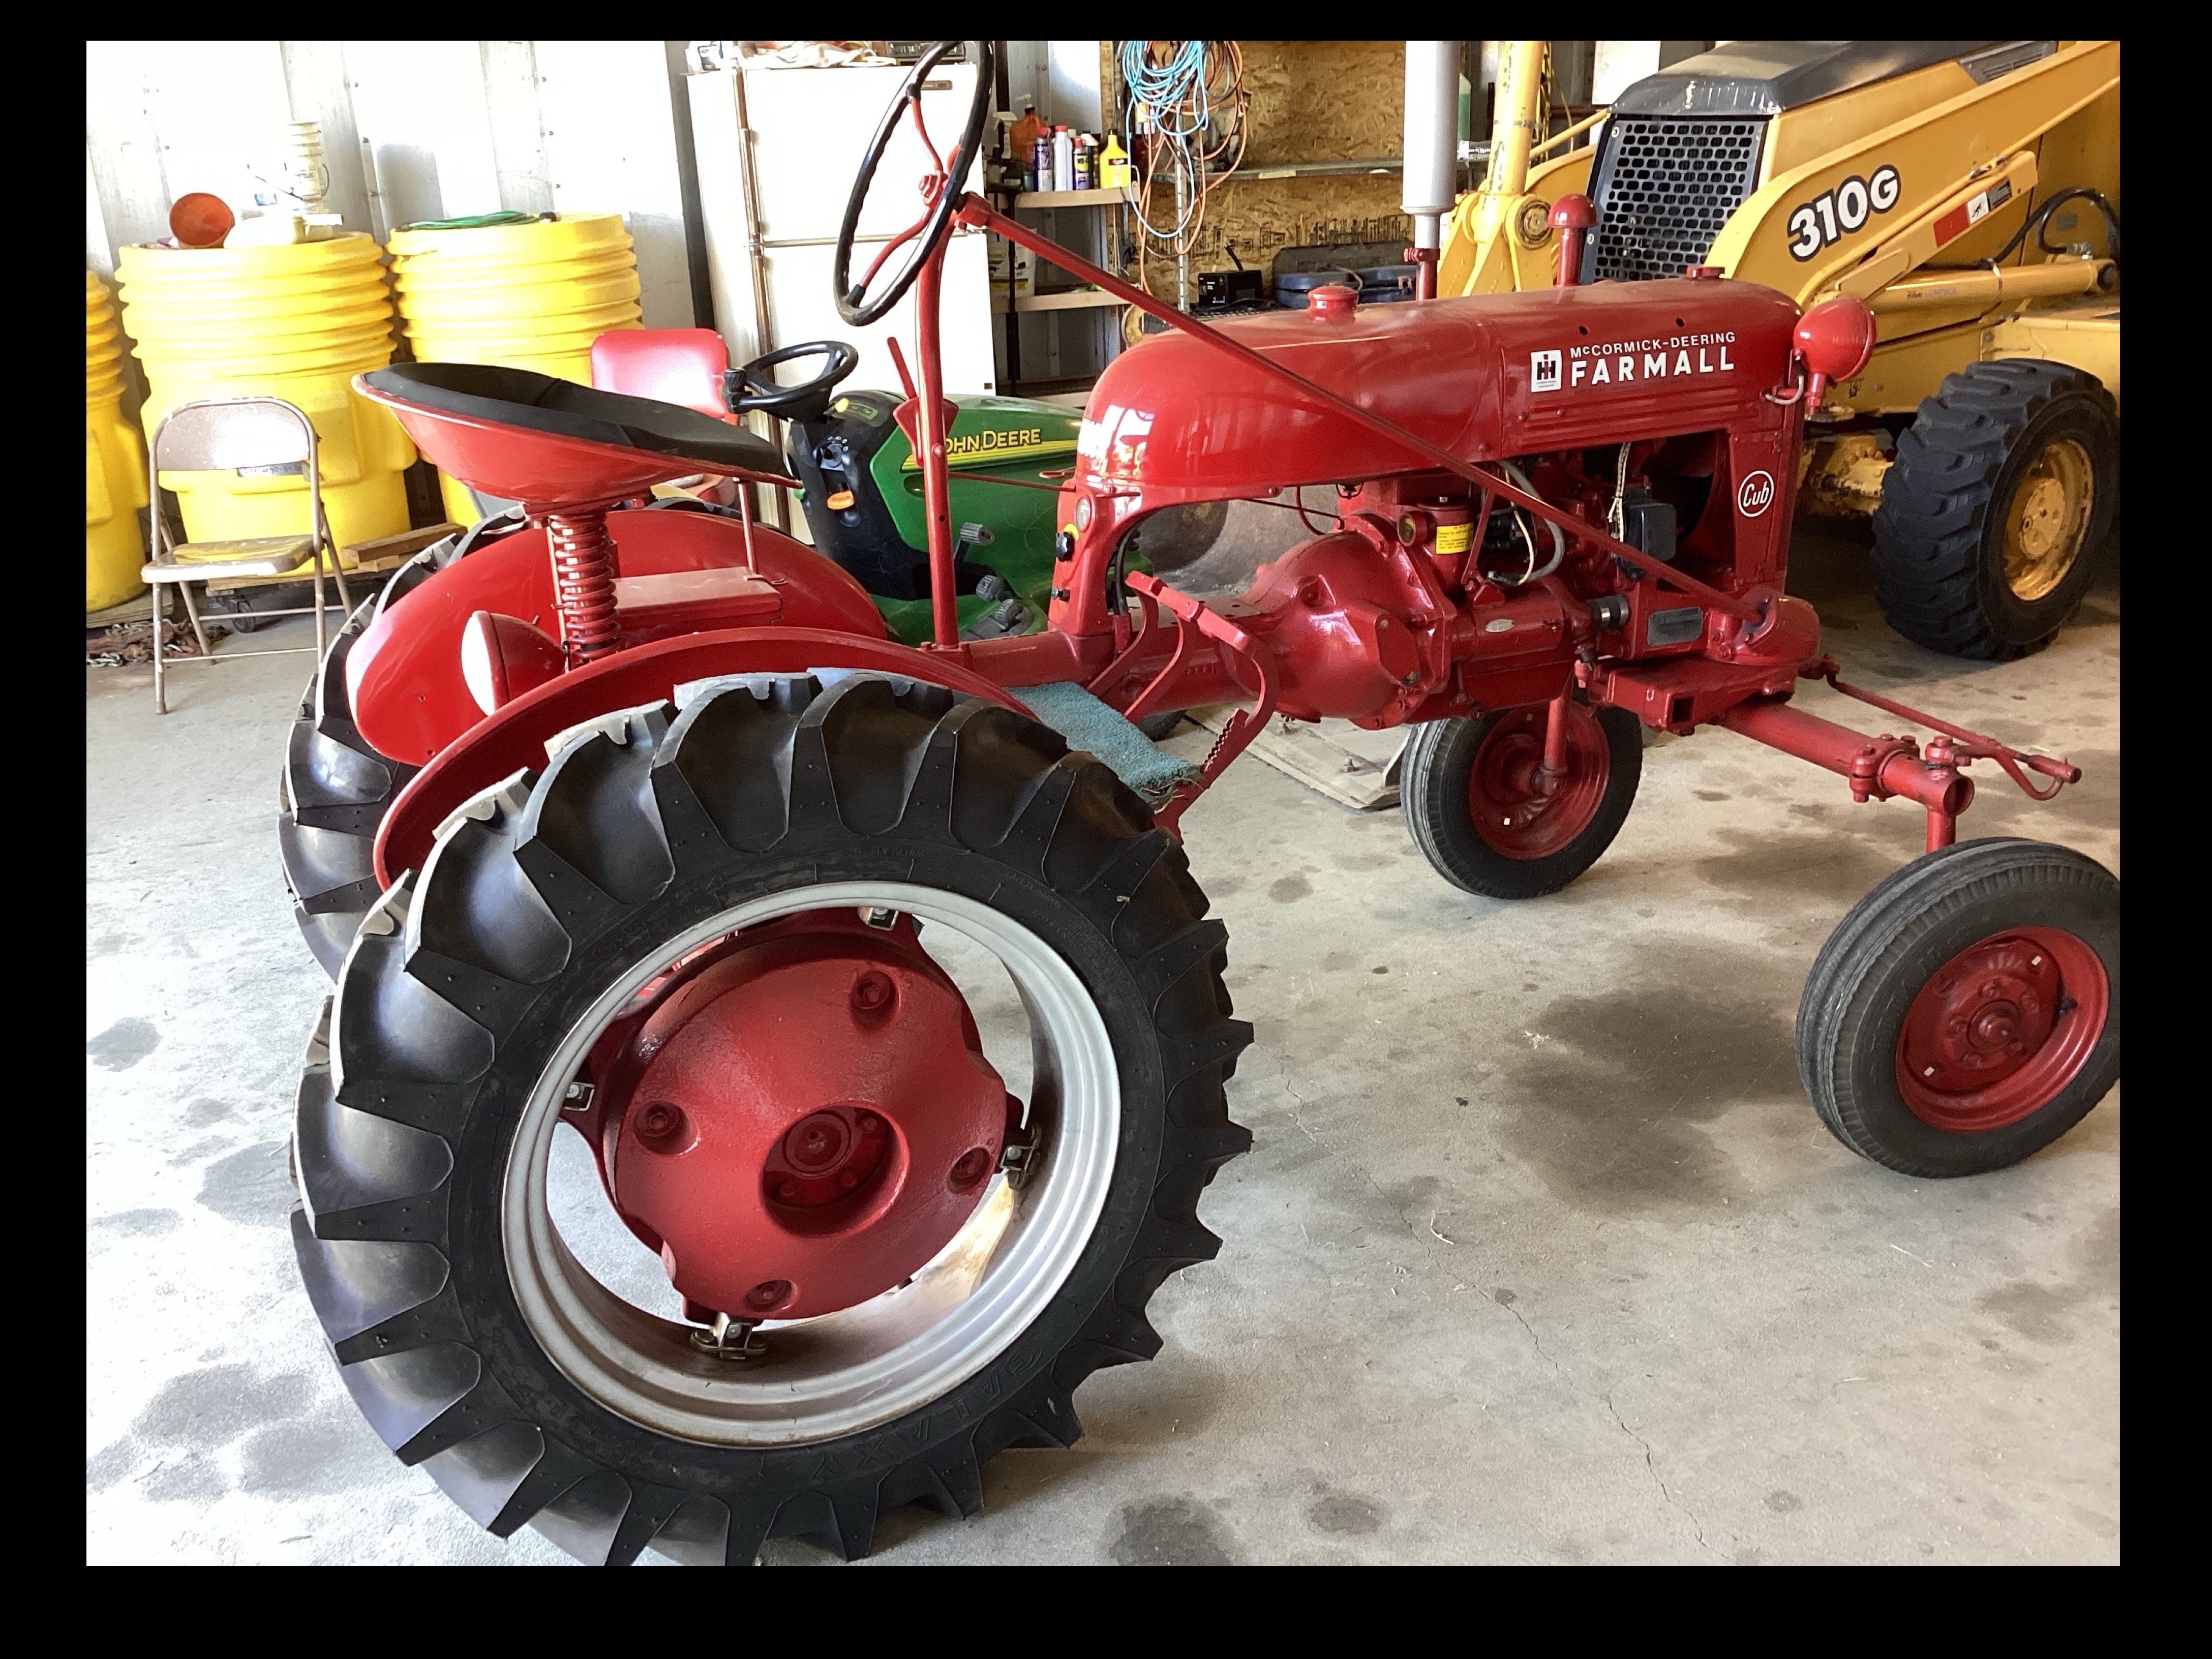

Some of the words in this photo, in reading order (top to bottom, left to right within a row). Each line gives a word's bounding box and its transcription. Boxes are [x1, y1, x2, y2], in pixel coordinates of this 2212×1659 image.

[1789, 166, 1900, 260] 310G
[1570, 331, 1736, 358] McCORMICK-DEERING
[1571, 346, 1735, 387] FARMALL
[946, 435, 982, 454] OHN
[983, 429, 1041, 450] DEERE
[1743, 481, 1770, 507] Cub
